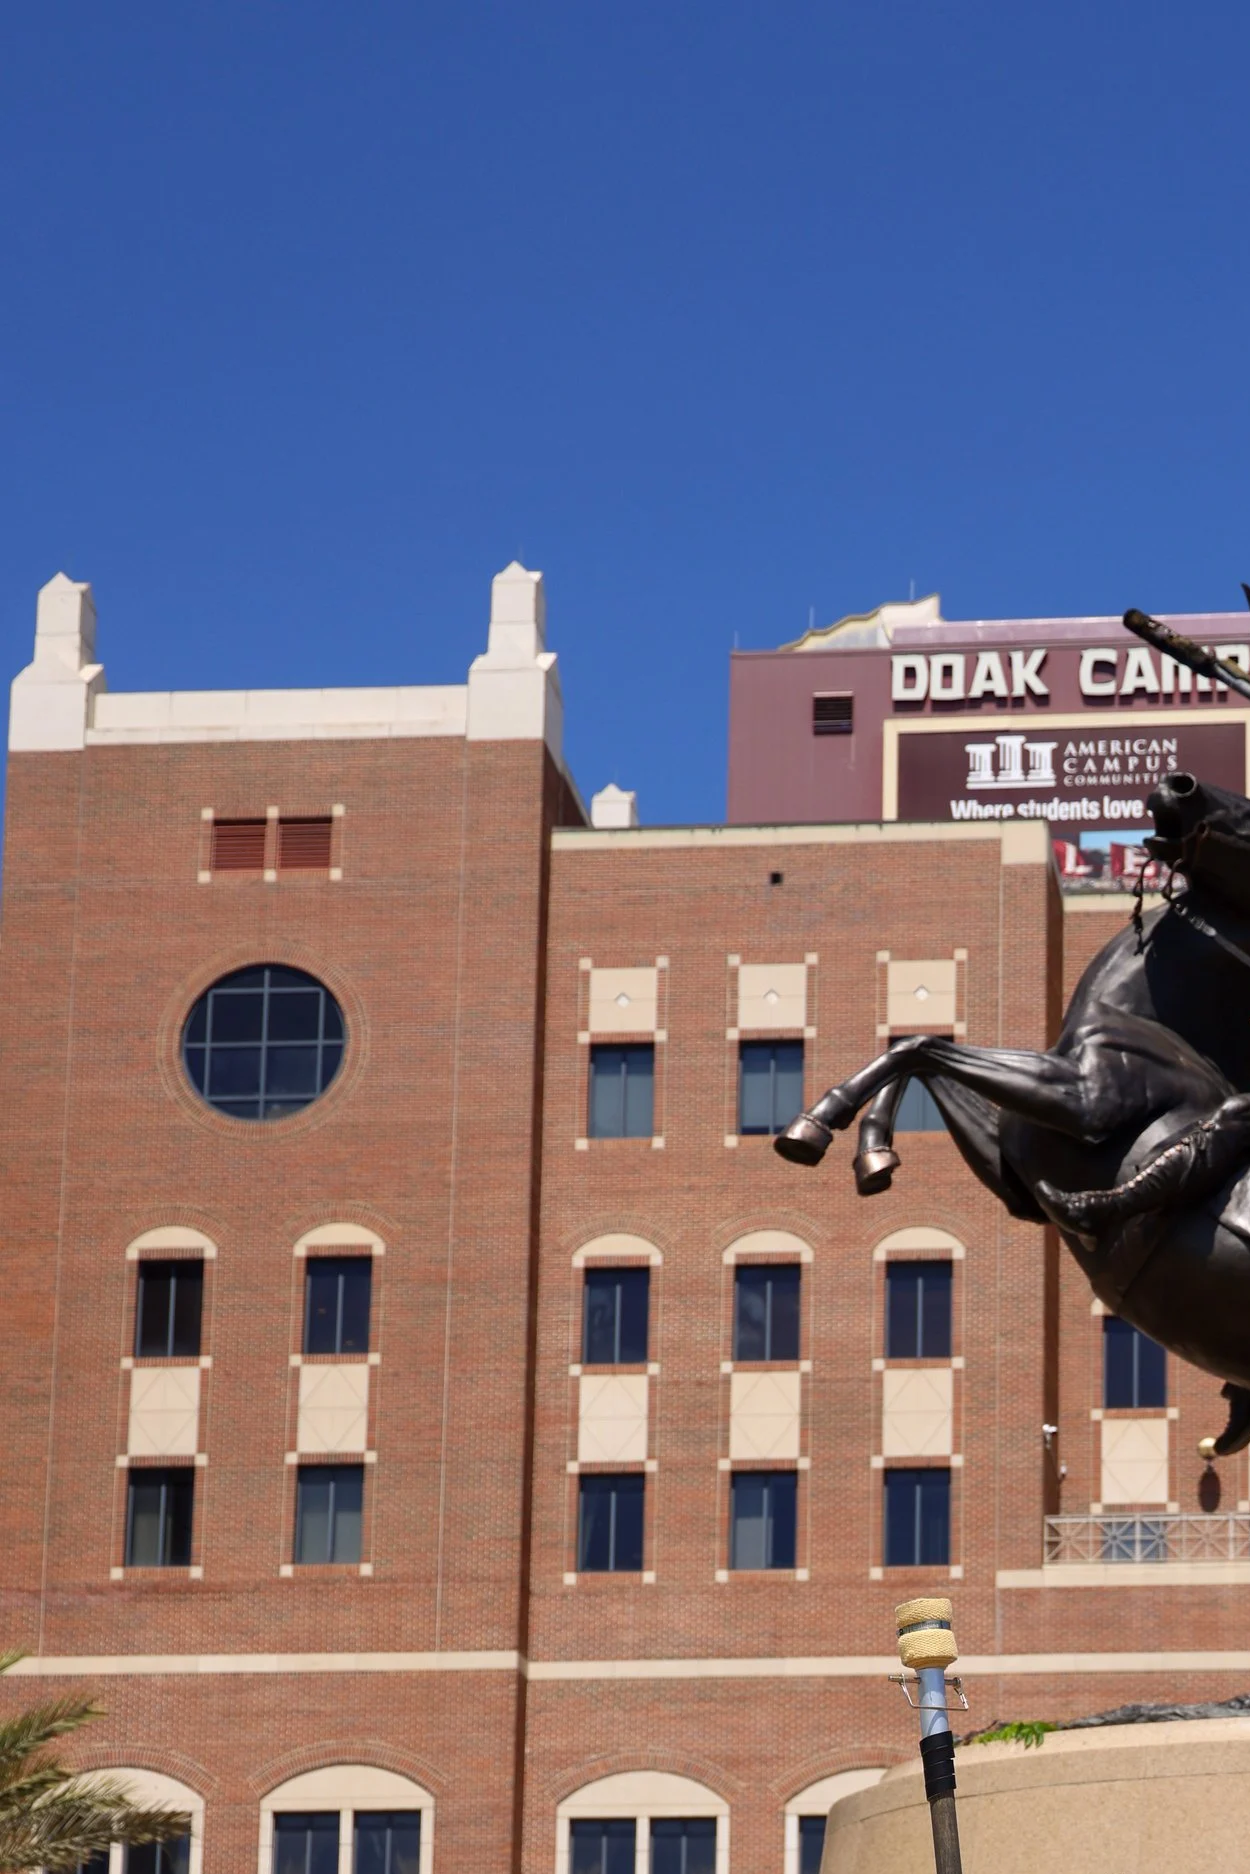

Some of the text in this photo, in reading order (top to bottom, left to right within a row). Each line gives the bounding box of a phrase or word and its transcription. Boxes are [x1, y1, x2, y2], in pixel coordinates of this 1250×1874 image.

[891, 648, 1050, 701] DOAK
[1063, 738, 1178, 757] AMERICAN
[1062, 755, 1178, 774] CAMPUS
[1063, 773, 1161, 787] COMMUNITI
[950, 800, 1015, 819] Where
[1103, 795, 1144, 819] love
